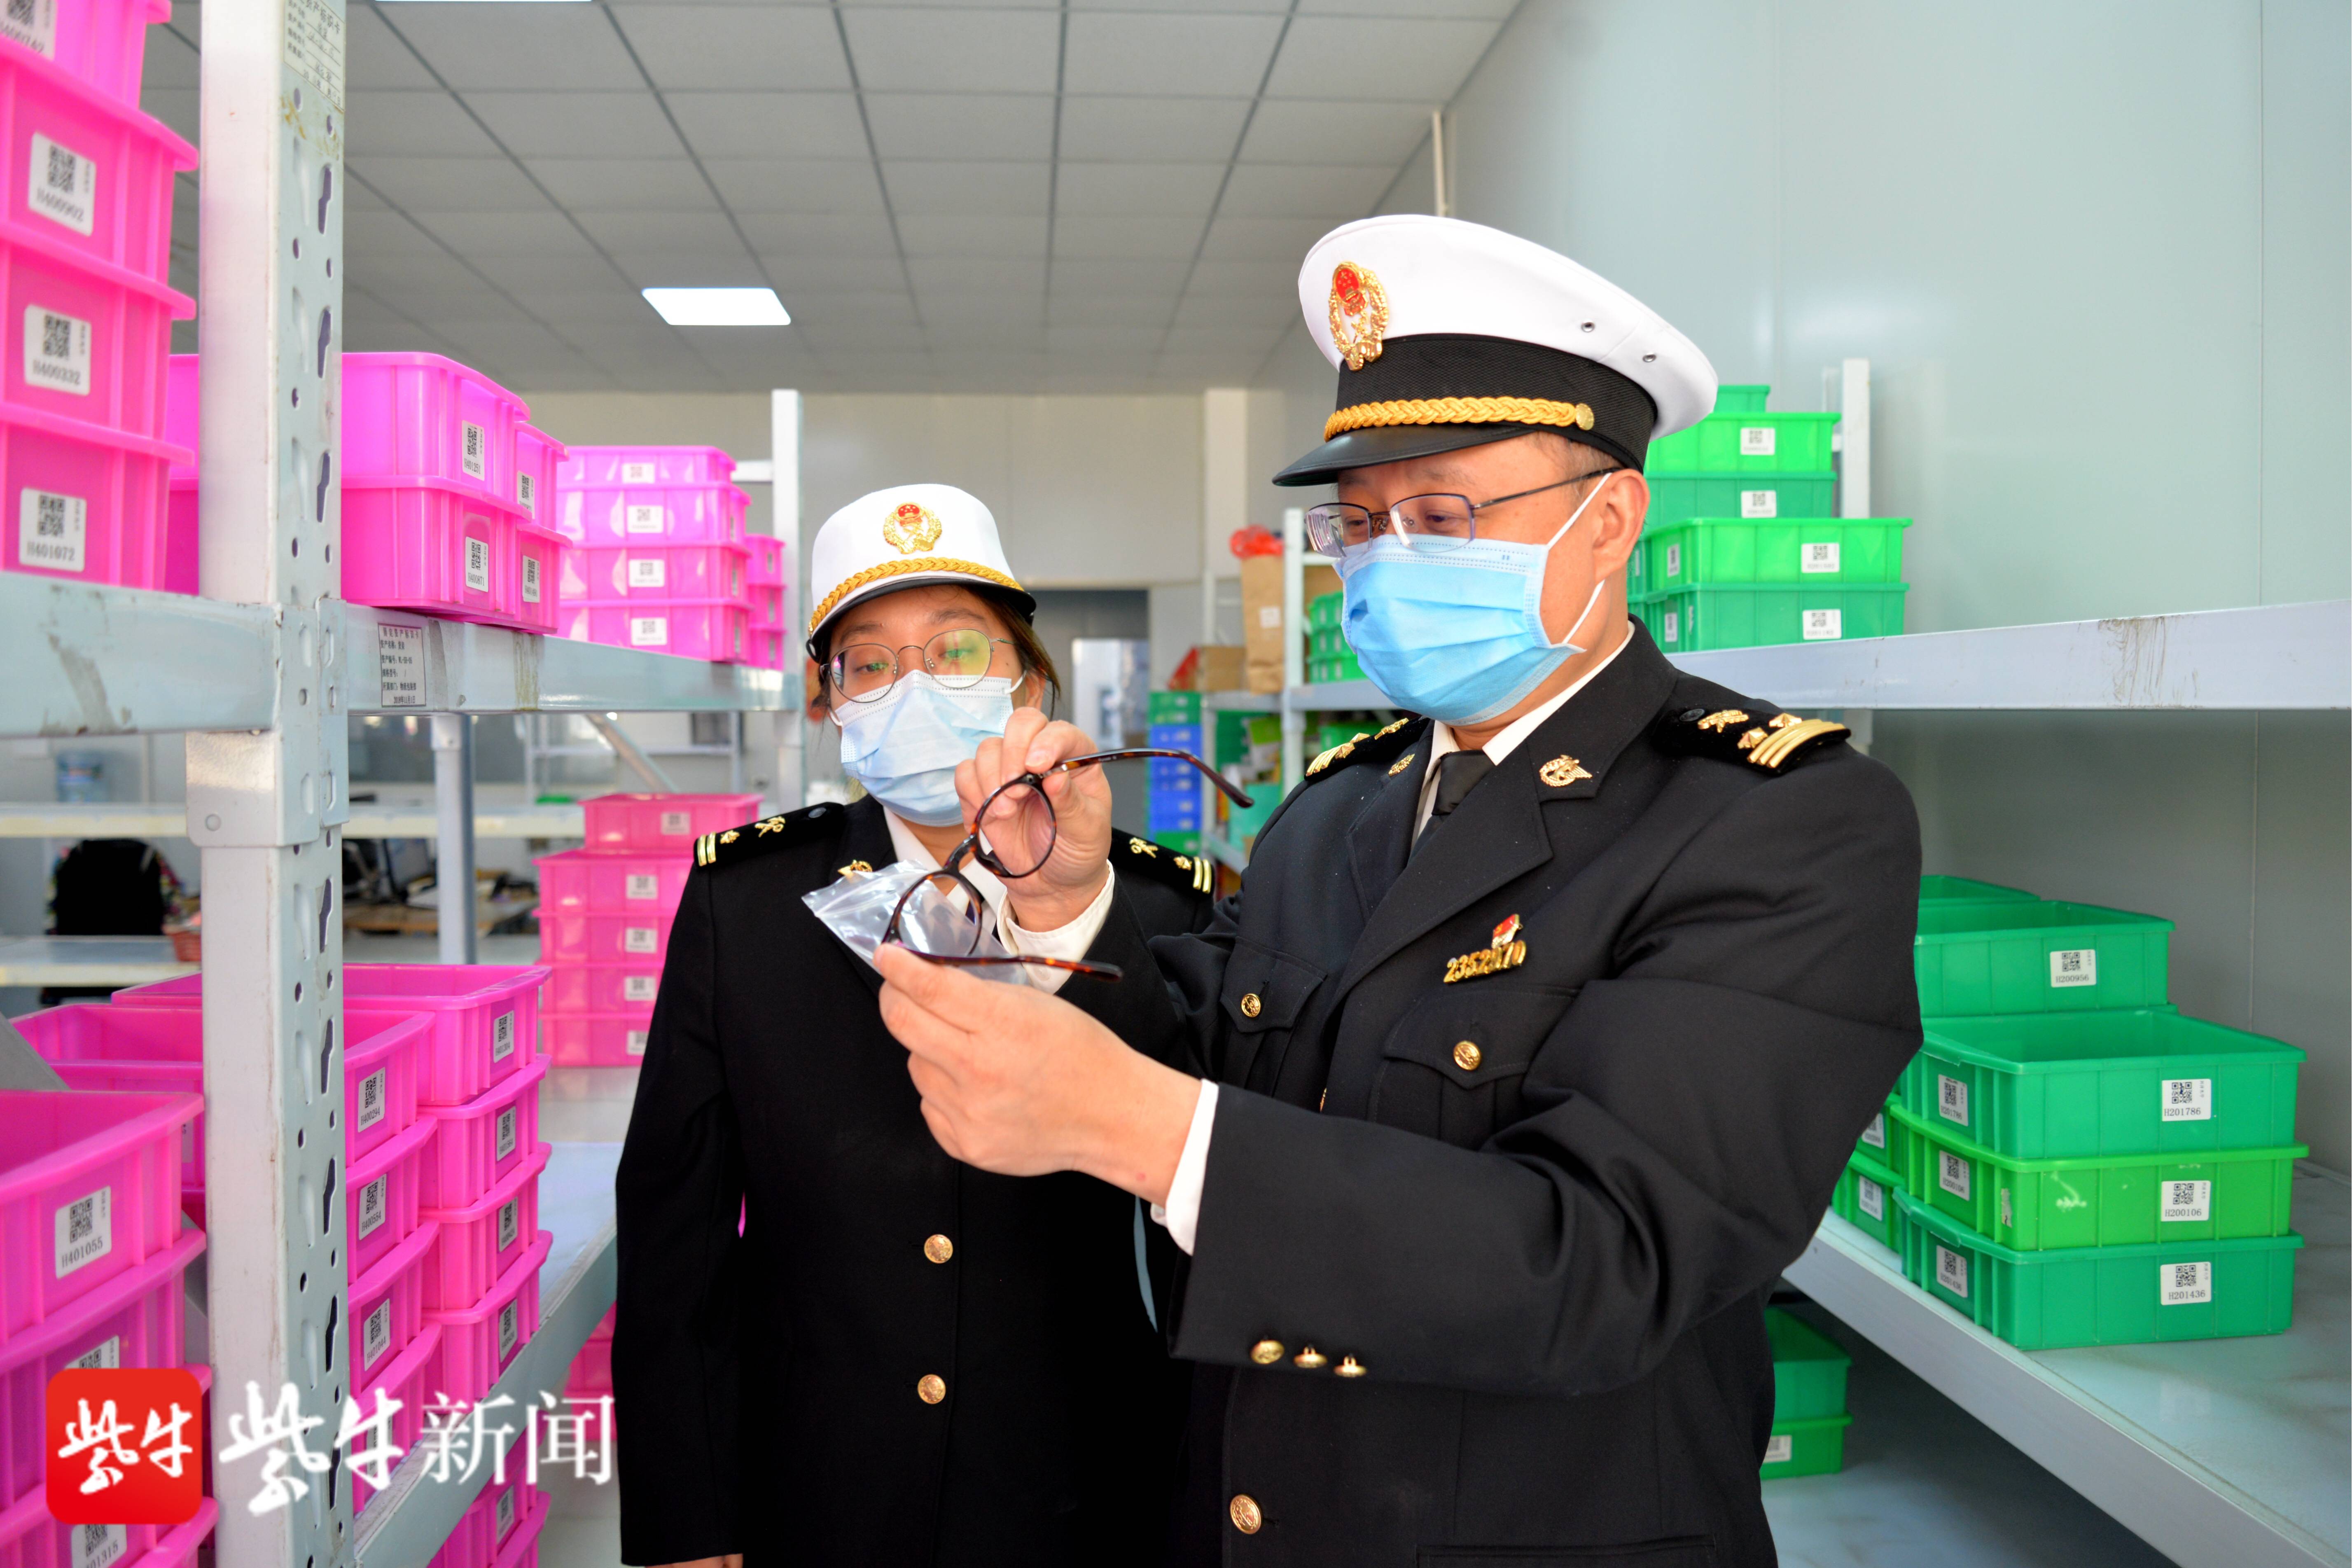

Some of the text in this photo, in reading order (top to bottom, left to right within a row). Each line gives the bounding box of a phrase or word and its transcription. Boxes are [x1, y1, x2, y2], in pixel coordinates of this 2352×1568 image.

[464, 458, 481, 474] H401251
[27, 541, 75, 561] H401072
[468, 572, 484, 586] H400871
[2055, 974, 2089, 983] H200956
[361, 1106, 380, 1126] H400294
[2164, 1107, 2201, 1117] H201786
[2165, 1208, 2202, 1217] H200106
[362, 1210, 381, 1232] H400554
[62, 1236, 103, 1268] H401055
[2168, 1290, 2205, 1300] H201436
[367, 1335, 386, 1363] H401044
